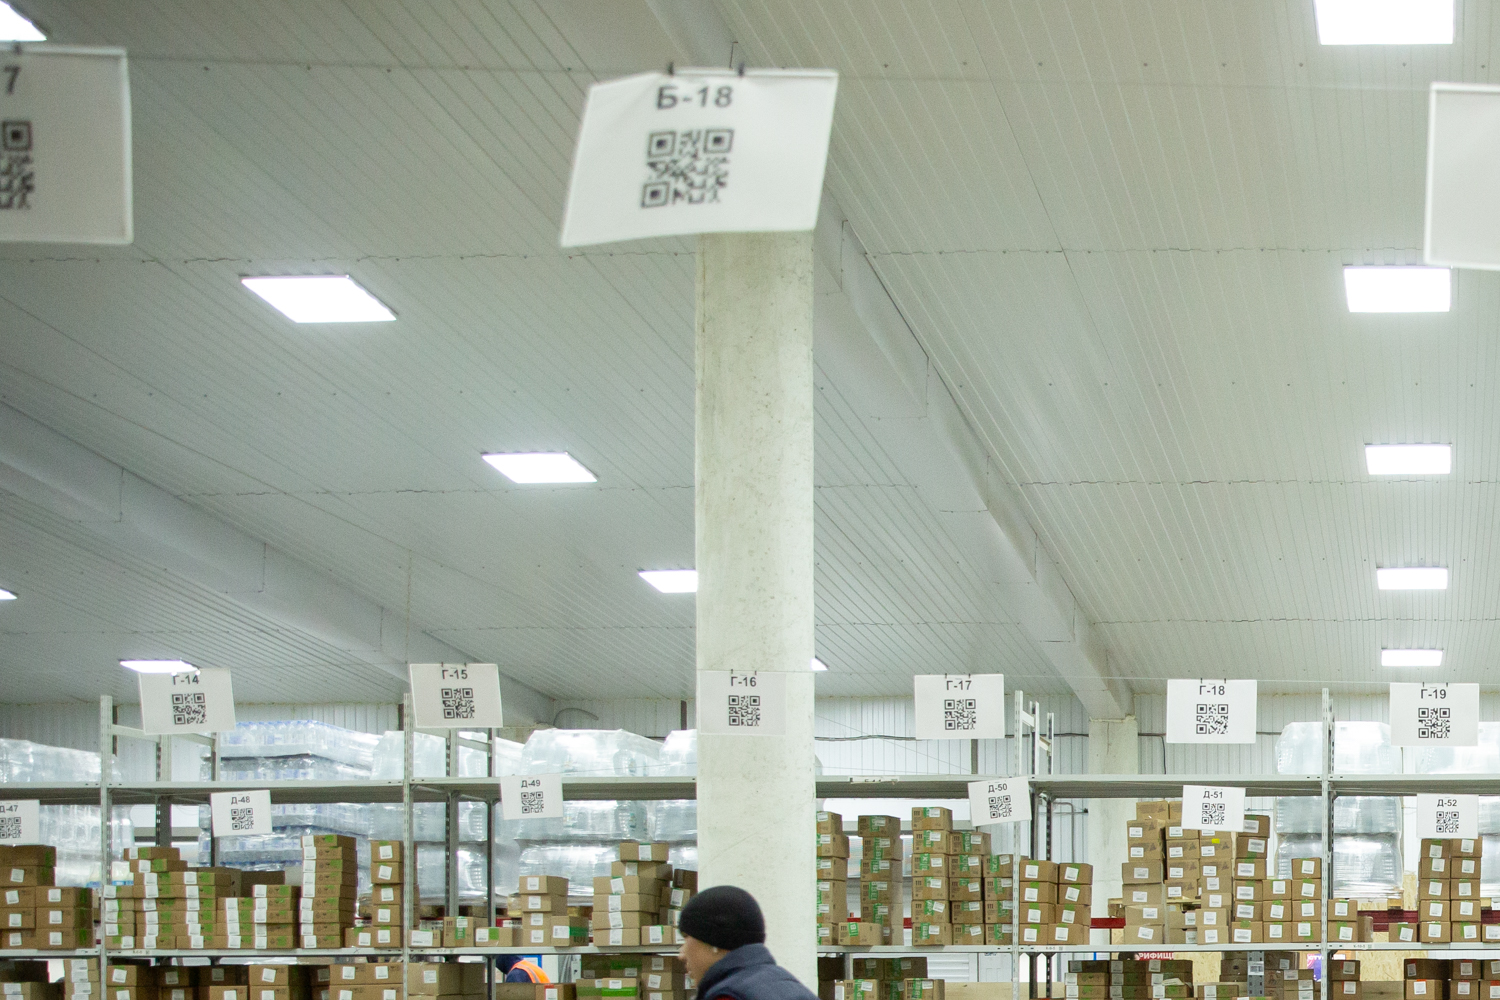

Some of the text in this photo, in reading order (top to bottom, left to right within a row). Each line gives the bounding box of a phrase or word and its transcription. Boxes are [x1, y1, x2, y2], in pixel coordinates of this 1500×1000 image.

[654, 85, 733, 111] Б-18
[441, 668, 468, 680] Г-15
[172, 674, 200, 686] Г-14
[731, 676, 757, 687] Г-16
[946, 680, 972, 691] Г-17
[1199, 685, 1226, 696] Г-18
[1421, 688, 1447, 700] Г-19
[520, 779, 541, 789] Д-49
[987, 782, 1008, 794] Д-50
[230, 796, 251, 805] Д-48
[1202, 790, 1224, 800] Д-51
[1436, 798, 1458, 808] Д-52
